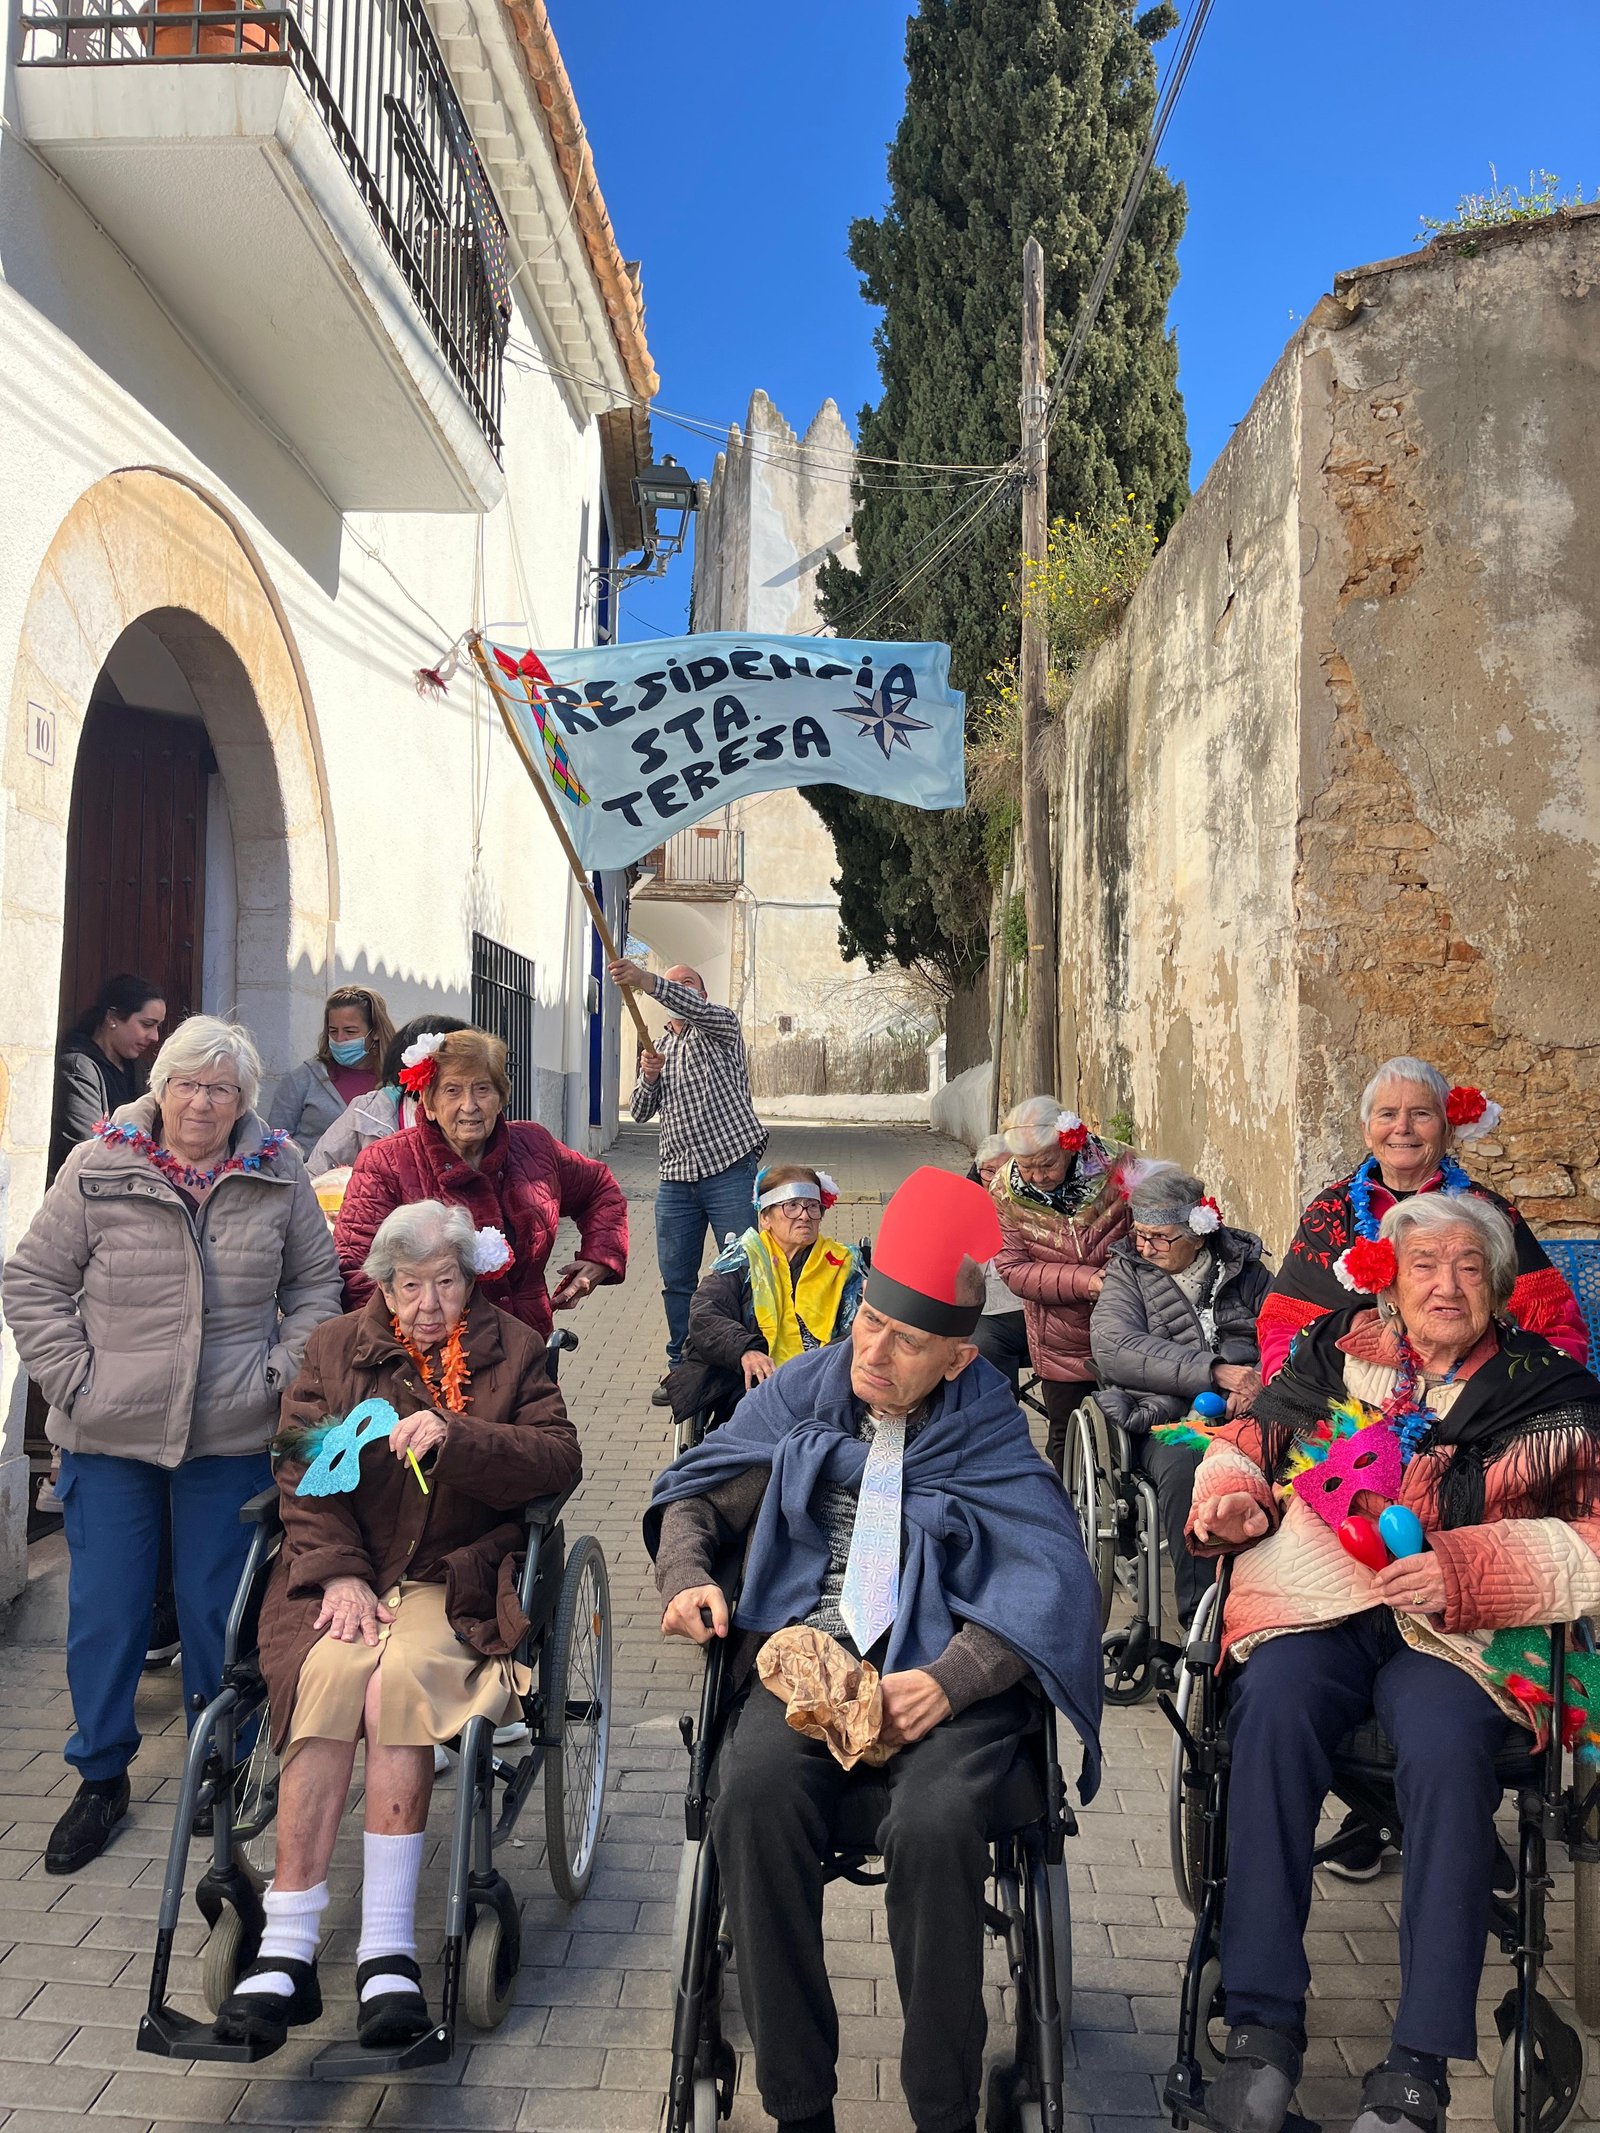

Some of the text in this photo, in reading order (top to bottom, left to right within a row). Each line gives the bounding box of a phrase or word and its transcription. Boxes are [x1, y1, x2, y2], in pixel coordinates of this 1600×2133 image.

[36, 716, 50, 753] 10
[601, 715, 831, 827] TERESA
[630, 694, 762, 775] STA.
